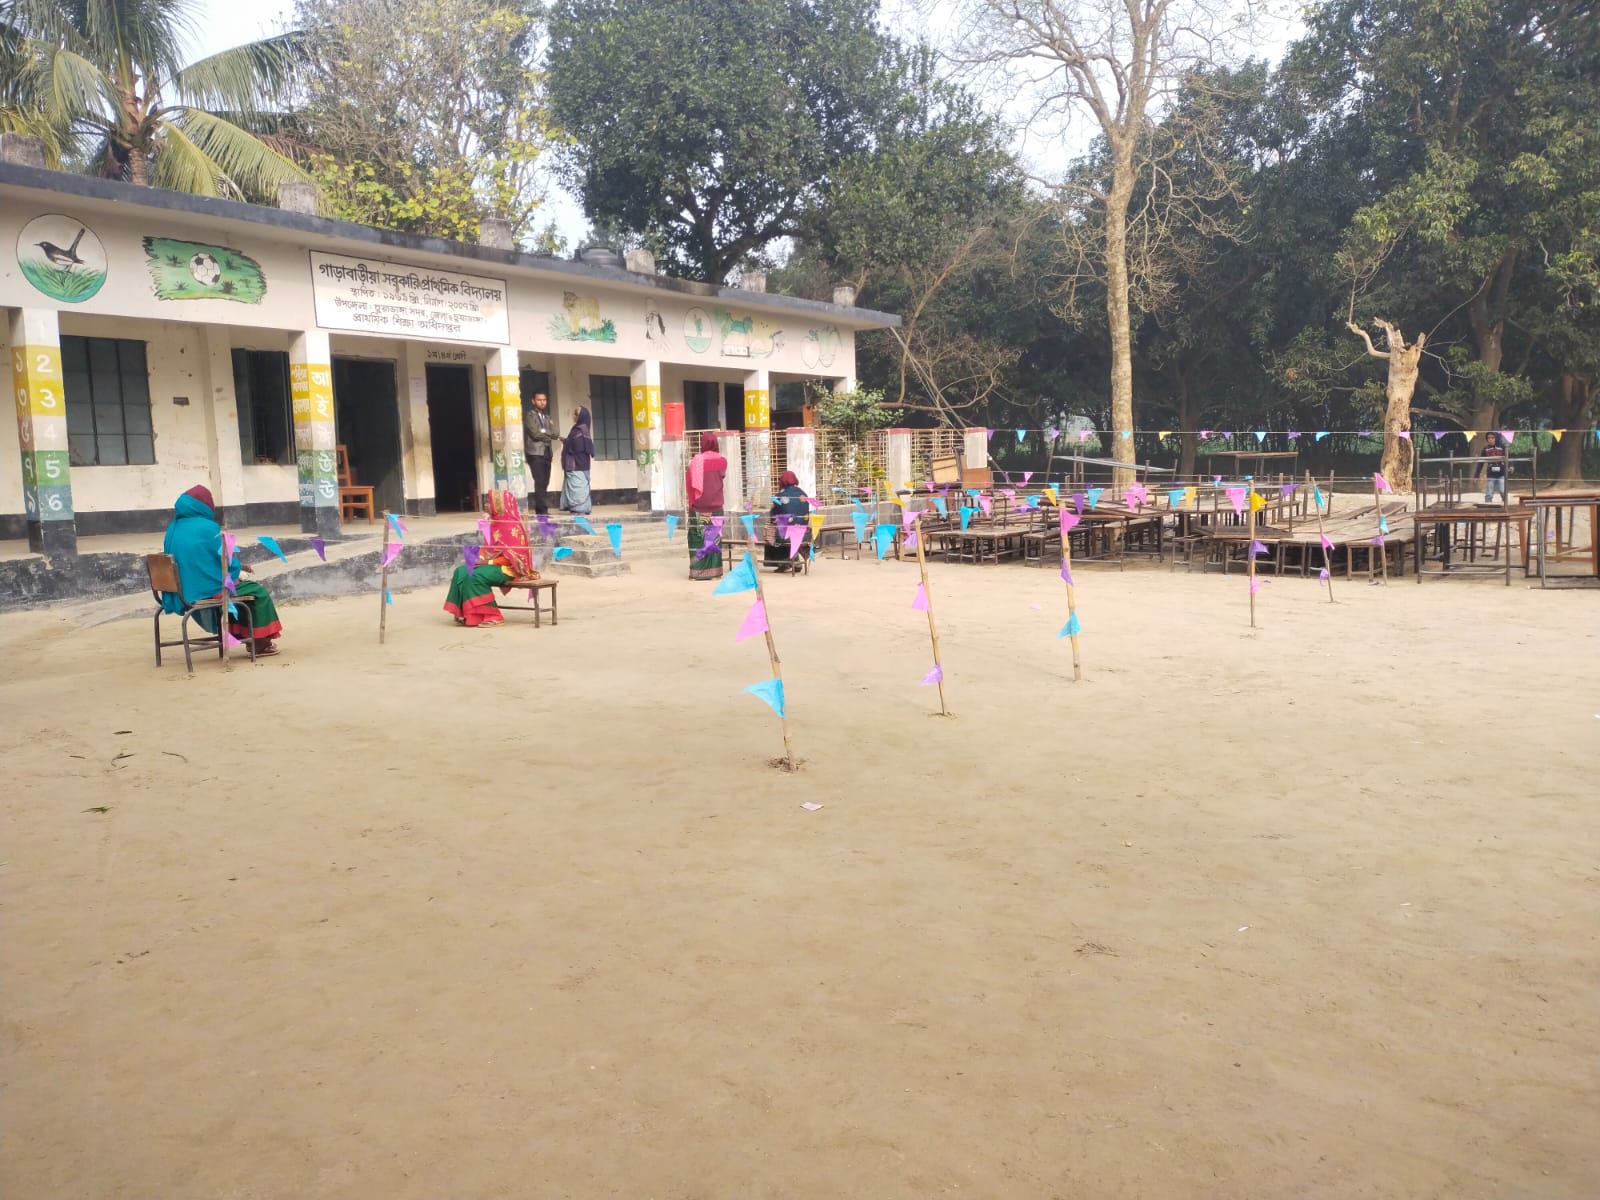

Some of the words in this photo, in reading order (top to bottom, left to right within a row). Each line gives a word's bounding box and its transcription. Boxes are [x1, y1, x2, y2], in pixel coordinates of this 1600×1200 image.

[460, 281, 502, 301] বিদ্যালয়
[35, 353, 54, 373] 2
[40, 388, 57, 408] 3
[747, 394, 756, 405] T
[748, 413, 756, 425] U
[44, 423, 57, 441] 4
[45, 460, 61, 478] 5
[48, 493, 63, 511] 6
